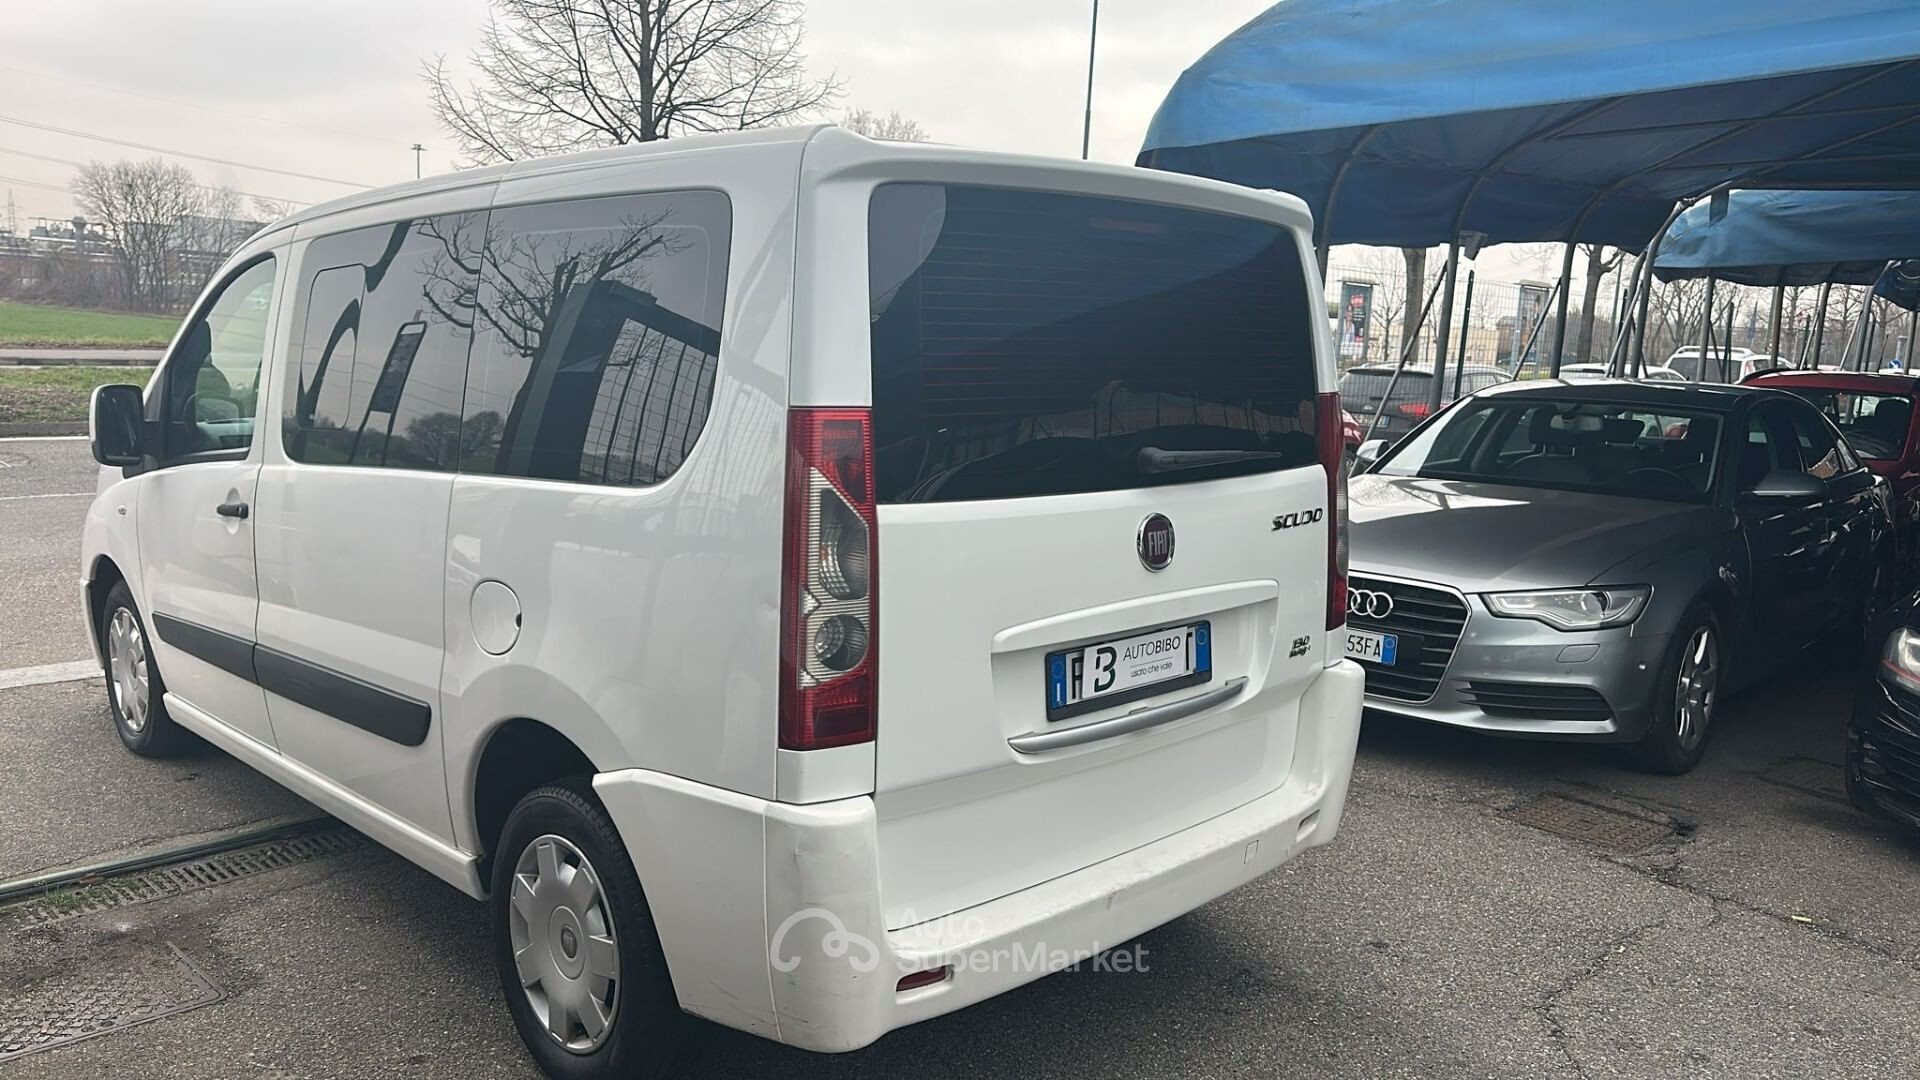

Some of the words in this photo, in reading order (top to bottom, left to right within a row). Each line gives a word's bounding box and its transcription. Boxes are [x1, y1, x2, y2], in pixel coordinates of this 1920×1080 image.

[1272, 508, 1323, 531] SCUDO
[1148, 530, 1168, 557] FIAT
[1123, 636, 1181, 661] AUTOBIBO
[1347, 634, 1381, 657] 53FA
[1131, 667, 1147, 678] usato
[1148, 664, 1160, 674] che
